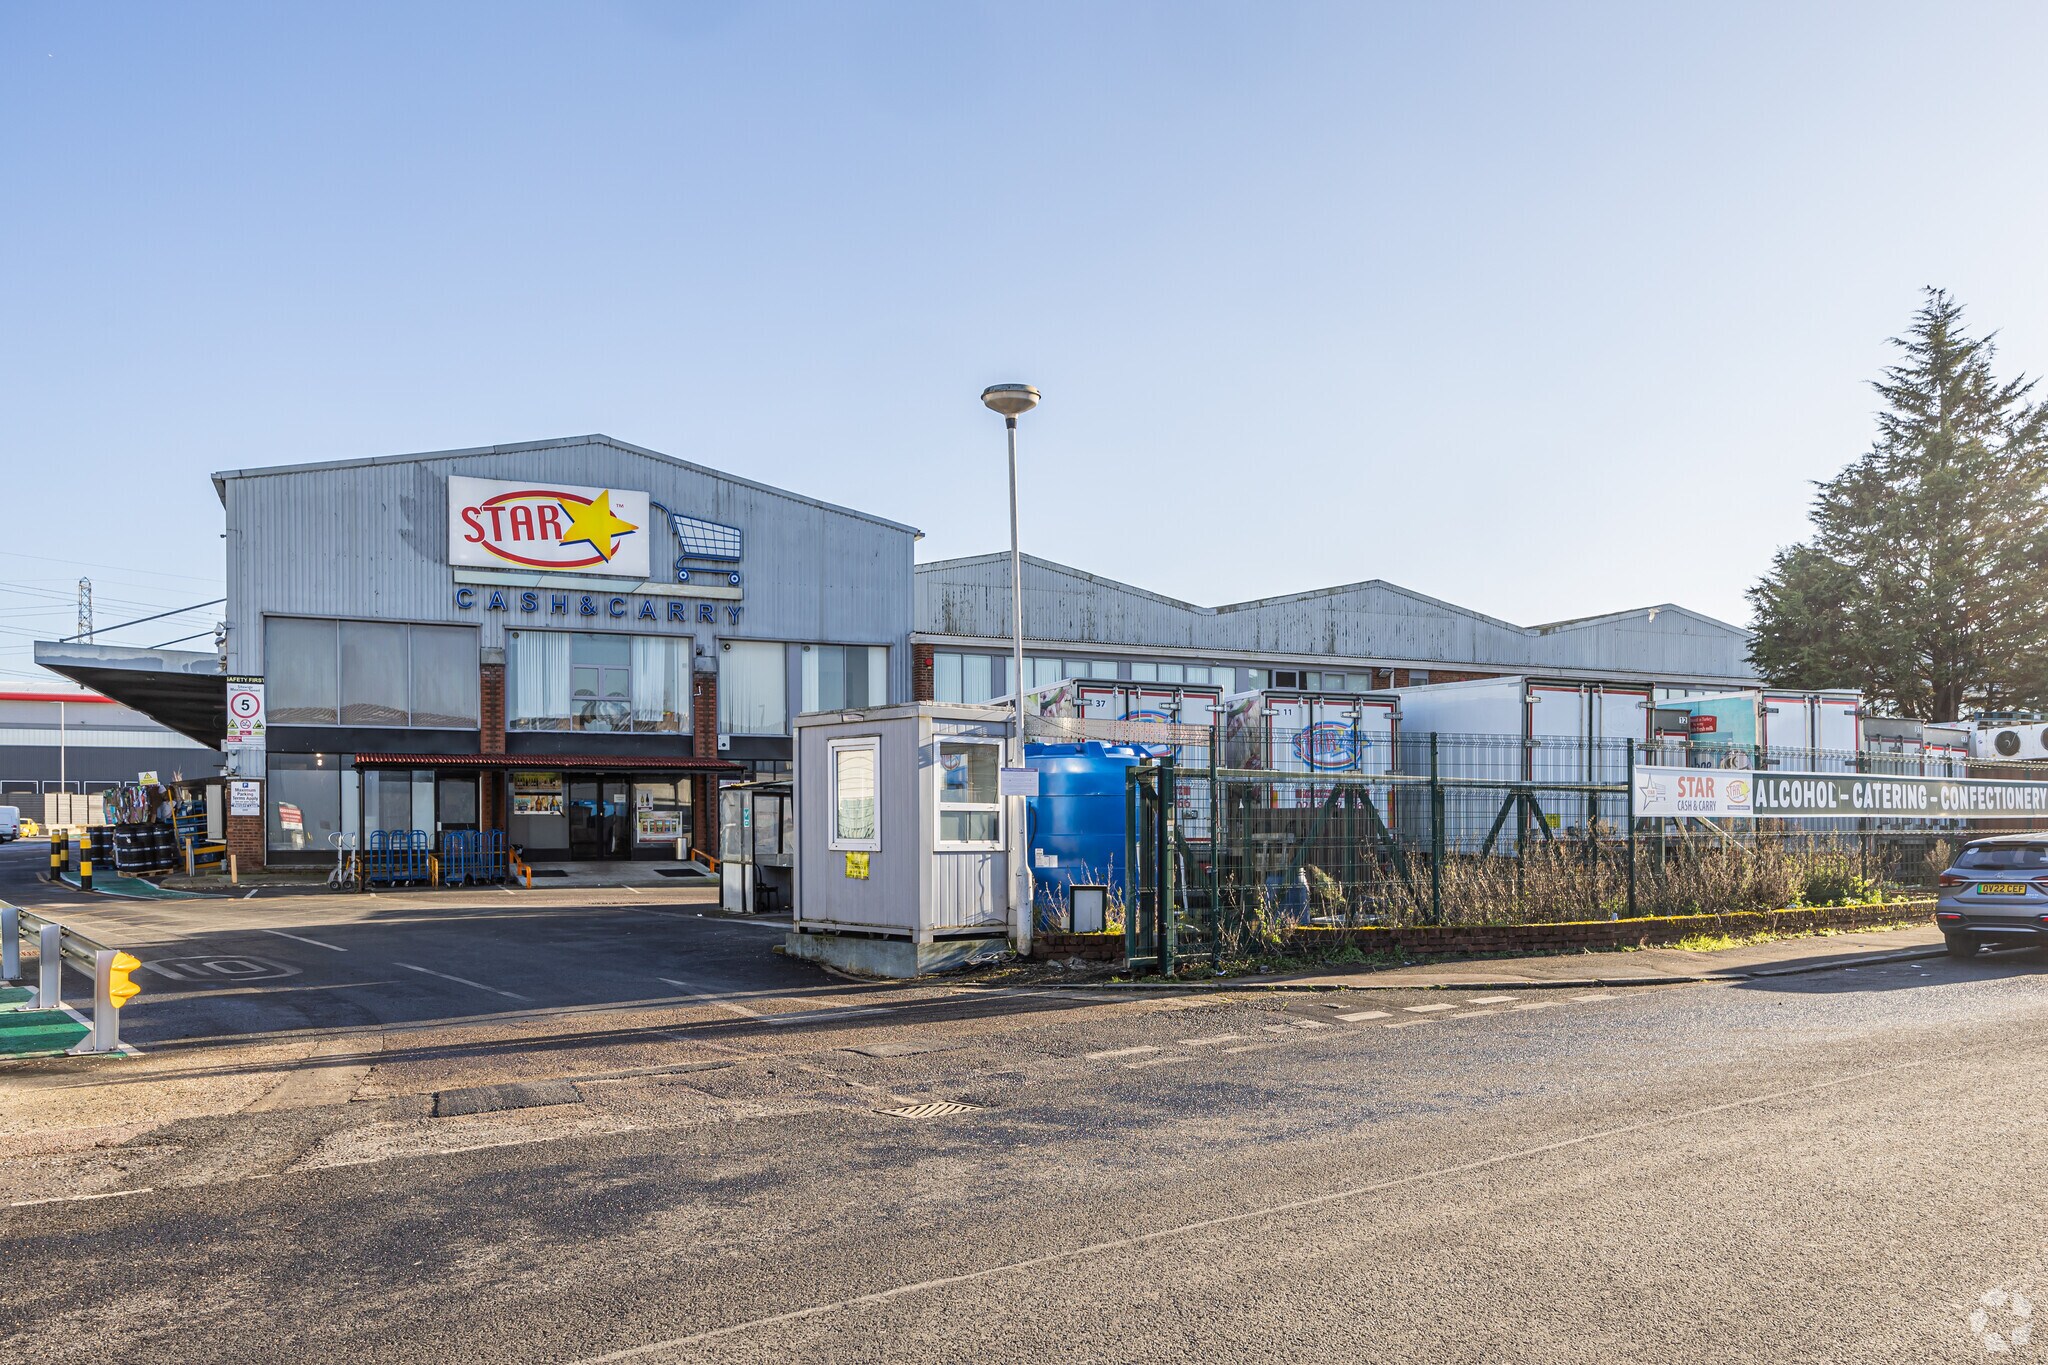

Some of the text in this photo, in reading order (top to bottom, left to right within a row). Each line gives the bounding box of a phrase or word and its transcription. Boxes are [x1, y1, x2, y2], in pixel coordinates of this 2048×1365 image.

[461, 505, 563, 543] STAR
[241, 699, 250, 711] 5
[1095, 700, 1106, 708] 37
[1283, 708, 1292, 716] 11
[1294, 730, 1337, 757] STAR
[1677, 776, 1715, 798] STAR
[1755, 779, 1837, 808] ALCOHOL
[1852, 782, 1927, 810] CATERING
[1940, 785, 2048, 811] CONFECTIONERY
[1677, 801, 1692, 811] CASH
[1693, 801, 1698, 811] &
[1698, 801, 1717, 812] CARRY
[2007, 884, 2025, 893] CEF
